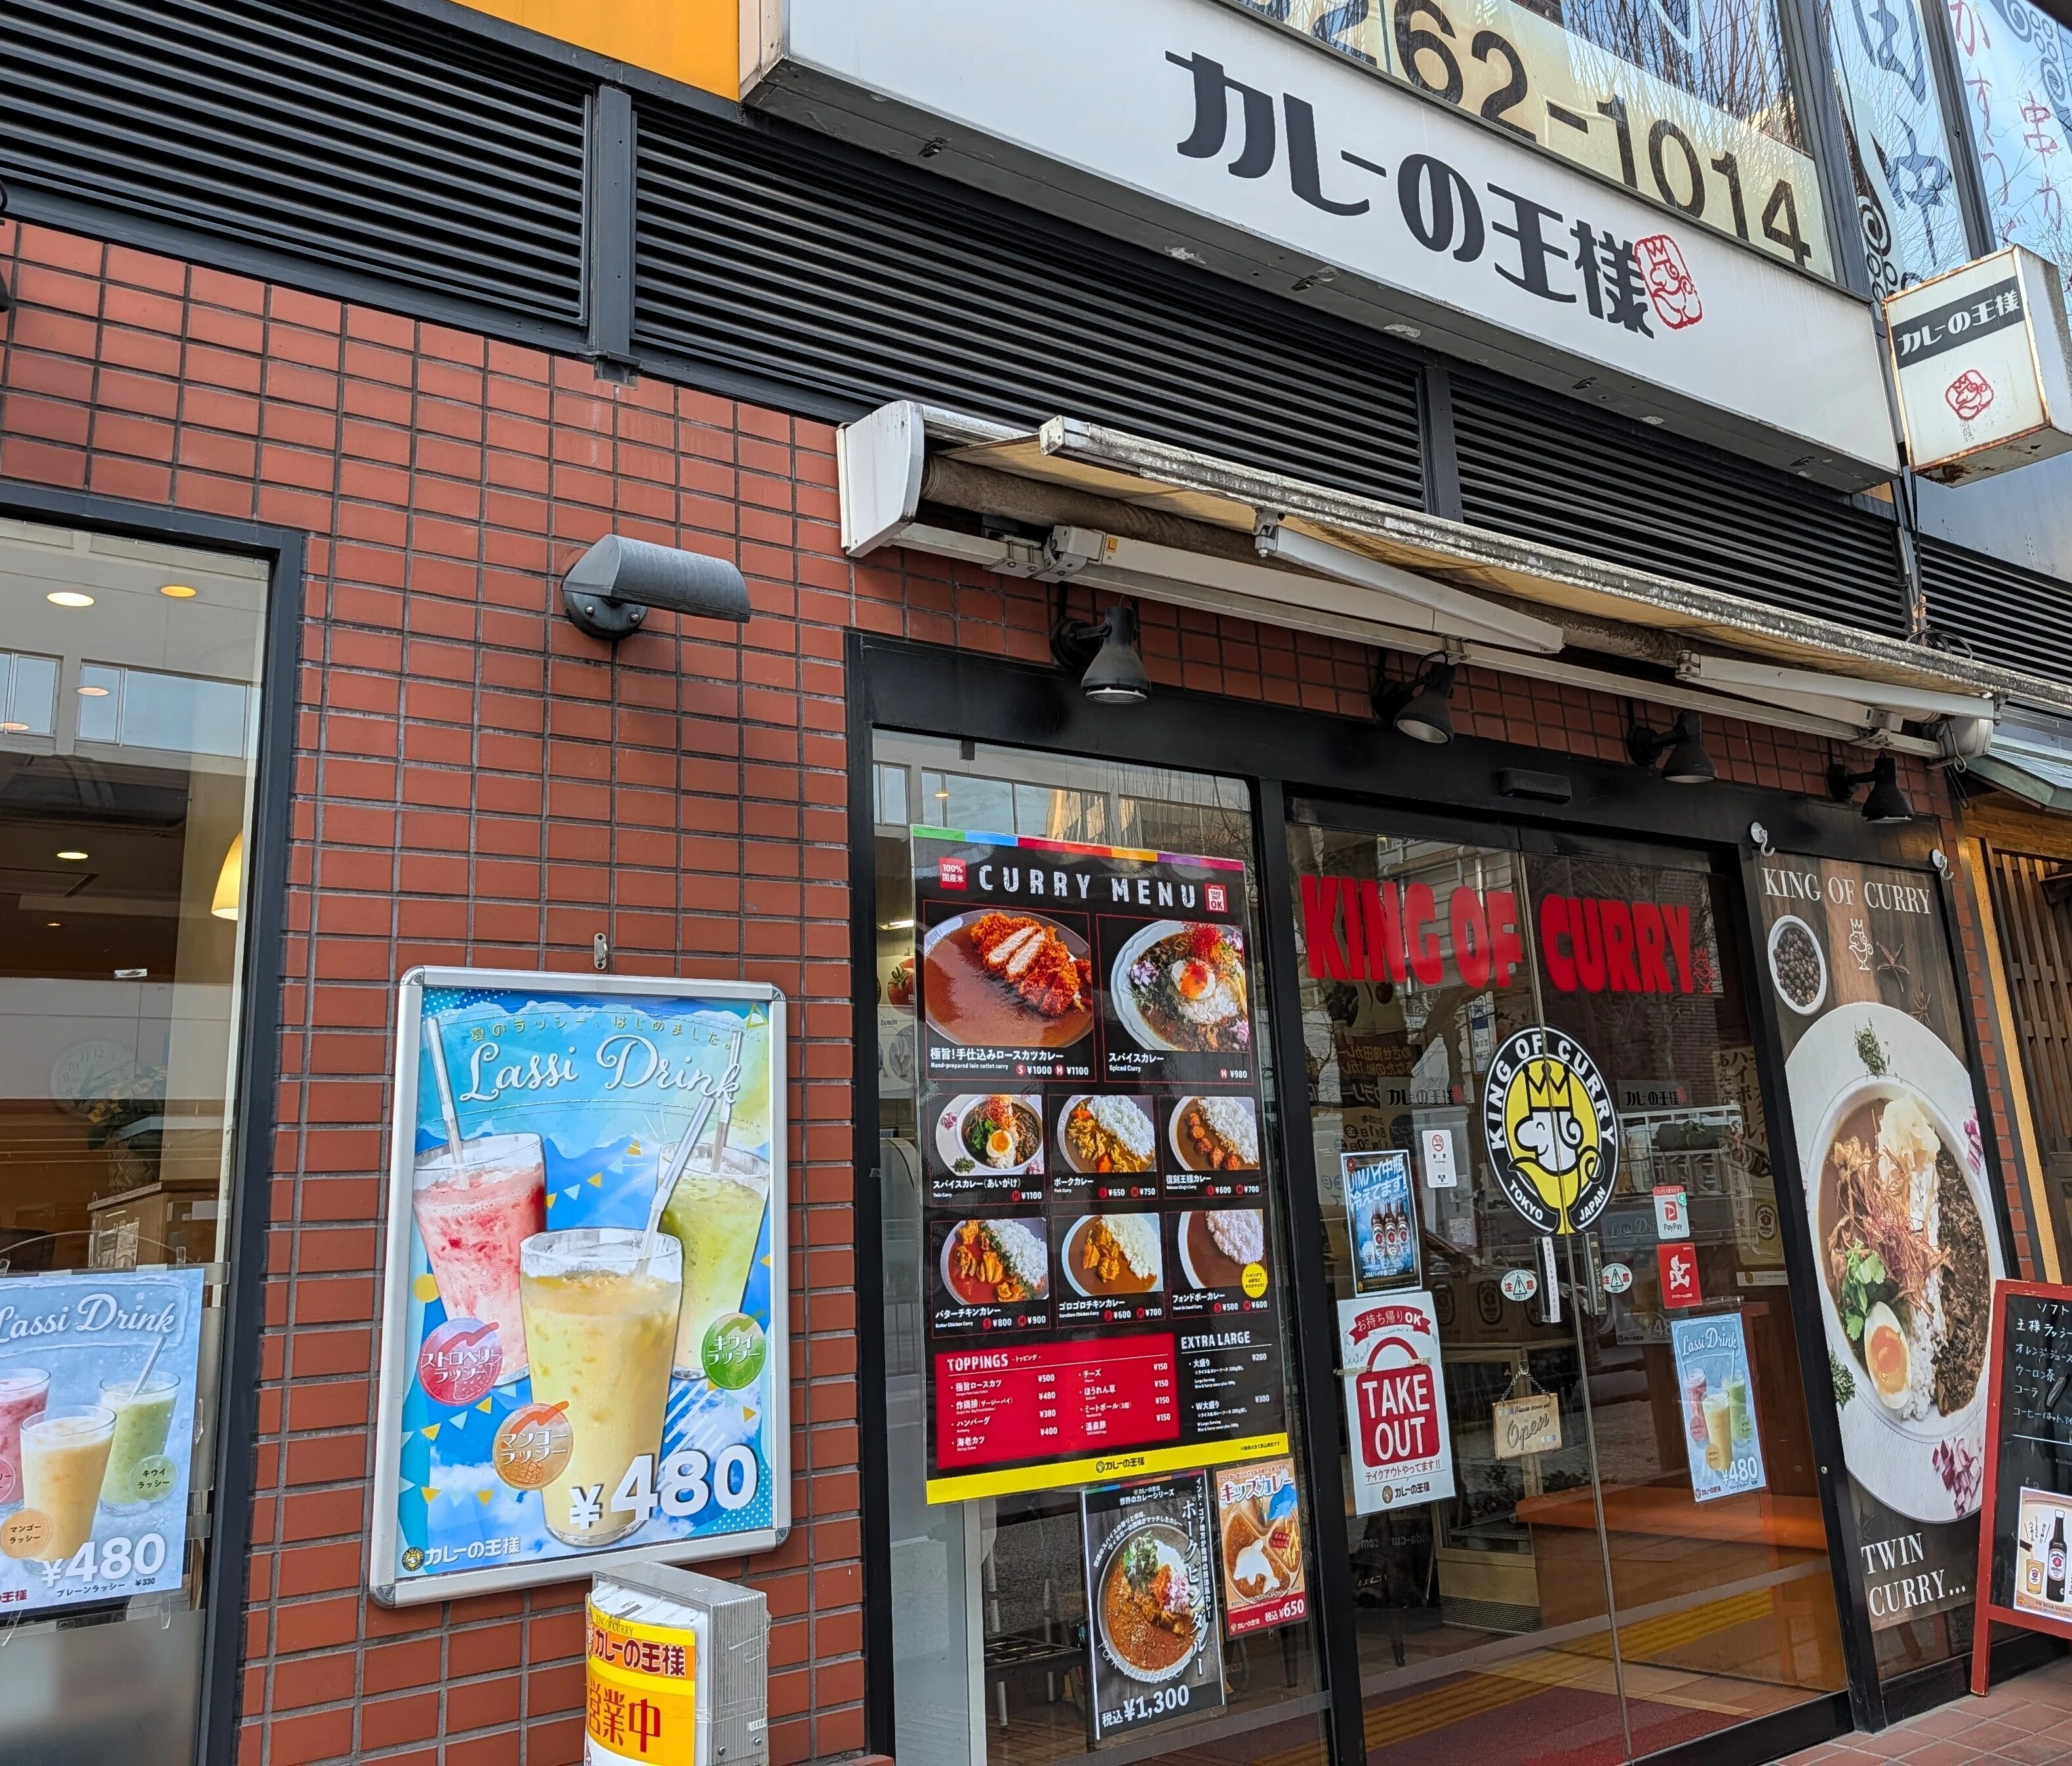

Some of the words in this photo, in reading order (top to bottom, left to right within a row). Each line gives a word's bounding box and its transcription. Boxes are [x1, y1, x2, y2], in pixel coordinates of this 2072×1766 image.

[1245, 0, 1812, 265] 262-1014
[1165, 50, 1654, 339] カレーの王様
[1897, 289, 2020, 357] カレーの王様
[942, 863, 963, 873] 100%
[942, 873, 965, 884] 国産米
[979, 865, 1091, 899] CURRY
[1111, 877, 1195, 908] MENU
[1761, 867, 1821, 901] KING
[1827, 876, 1856, 905] OF
[1863, 881, 1932, 914] CURRY
[1210, 900, 1224, 911] OK
[1301, 875, 1443, 985] KING
[1451, 886, 1523, 989] OF
[1540, 894, 1694, 994] CURRY
[469, 1014, 732, 1051] 夏のラッシー、はじめました。
[930, 1047, 1064, 1061] 極旨!手仕込みロースカツカレー
[1108, 1053, 1165, 1063] スパイスカレー
[459, 1040, 578, 1103] Lassi
[595, 1034, 742, 1105] Drink
[1027, 1065, 1052, 1075] ¥1000
[1066, 1066, 1089, 1076] ¥1100
[1229, 1069, 1248, 1079] ¥980
[1488, 1061, 1512, 1150] KING
[1515, 1034, 1542, 1060] OF
[1558, 1040, 1615, 1146] CURRY
[1625, 1090, 1680, 1107] カレーの王様
[1053, 1177, 1094, 1187] ポークカレー
[1215, 1186, 1231, 1194] ¥600
[1244, 1185, 1260, 1194] ¥700
[1021, 1191, 1043, 1200] ¥1100
[1108, 1188, 1125, 1197] ¥650
[1140, 1188, 1156, 1196] ¥750
[1349, 1171, 1408, 1212] 冷えてます!
[1509, 1180, 1544, 1221] TOKYO
[1579, 1186, 1606, 1221] JAPAN
[1664, 1223, 1683, 1232] PayPay
[935, 1307, 1001, 1319] バターチキンカレー
[1058, 1299, 1126, 1310] ゴロゴロチキンカレー
[1222, 1302, 1239, 1312] ¥500
[1252, 1300, 1268, 1309] ¥600
[2037, 1303, 2069, 1316] ソフト
[0, 1305, 71, 1343] Lassi
[75, 1293, 177, 1333] Drink
[993, 1318, 1012, 1327] ¥800
[1027, 1315, 1046, 1324] ¥900
[1113, 1310, 1132, 1320] ¥600
[1146, 1308, 1163, 1317] ¥700
[1357, 1310, 1422, 1332] お持ち帰りOK
[2016, 1318, 2072, 1339] 王様ラッシー
[713, 1333, 754, 1350] キウイ
[1181, 1333, 1216, 1350] EXTRA
[1217, 1331, 1251, 1346] LARGE
[1682, 1334, 1705, 1358] Lassi
[1705, 1327, 1738, 1349] Drink
[706, 1347, 761, 1364] ラッシー
[947, 1353, 1008, 1372] TOPPINGS
[1193, 1358, 1210, 1368] 大盛り
[1252, 1353, 1267, 1362] ¥200
[2015, 1343, 2072, 1364] オレンジジュース
[433, 1365, 488, 1383] ラッシー
[1037, 1373, 1056, 1383] ¥500
[1083, 1367, 1102, 1379] チーズ
[1153, 1362, 1168, 1371] ¥150
[2016, 1364, 2056, 1383] ウーロン茶
[1154, 1379, 1169, 1388] ¥150
[2014, 1384, 2038, 1398] コーラ
[1038, 1391, 1056, 1400] ¥480
[1155, 1396, 1170, 1405] ¥150
[1195, 1400, 1220, 1411] W大盛り
[1254, 1394, 1270, 1403] ¥300
[1361, 1373, 1431, 1419] TAKE
[956, 1416, 991, 1427] ハンバーグ
[1039, 1409, 1056, 1419] ¥380
[1156, 1413, 1171, 1422] ¥150
[500, 1427, 568, 1449] マンゴー
[957, 1436, 985, 1447] 海老カツ
[1040, 1426, 1058, 1436] ¥400
[1375, 1416, 1426, 1461] OUT
[1508, 1413, 1549, 1451] Open
[499, 1443, 568, 1465] ラッシー
[142, 1468, 167, 1478] キウイ
[1105, 1456, 1146, 1472] カレーの王様
[1365, 1459, 1441, 1483] テイクアウトやってます!!
[1721, 1455, 1759, 1485] ¥480
[136, 1480, 170, 1489] ラッシー
[569, 1444, 758, 1531] ¥480
[1220, 1472, 1294, 1505] キッズカレー
[1394, 1481, 1431, 1499] カレーの王様
[1119, 1488, 1175, 1506] 世界のカレーシリーズ
[9, 1523, 42, 1533] マンゴー
[9, 1535, 41, 1544] ラッシー
[424, 1535, 521, 1567] カレーの王様
[1861, 1533, 1924, 1574] TWIN
[41, 1533, 166, 1588] ¥480
[56, 1582, 126, 1598] プレーンラッシー
[134, 1577, 155, 1586] ¥330
[1182, 1497, 1206, 1676] ポークビンダルー
[1869, 1569, 1966, 1617] CURRY...
[1279, 1598, 1304, 1619] ¥650
[595, 1628, 687, 1677] カレーの王様
[1102, 1710, 1124, 1728] 税込
[1123, 1684, 1189, 1722] ¥1,300
[588, 1678, 661, 1753] 営業中
